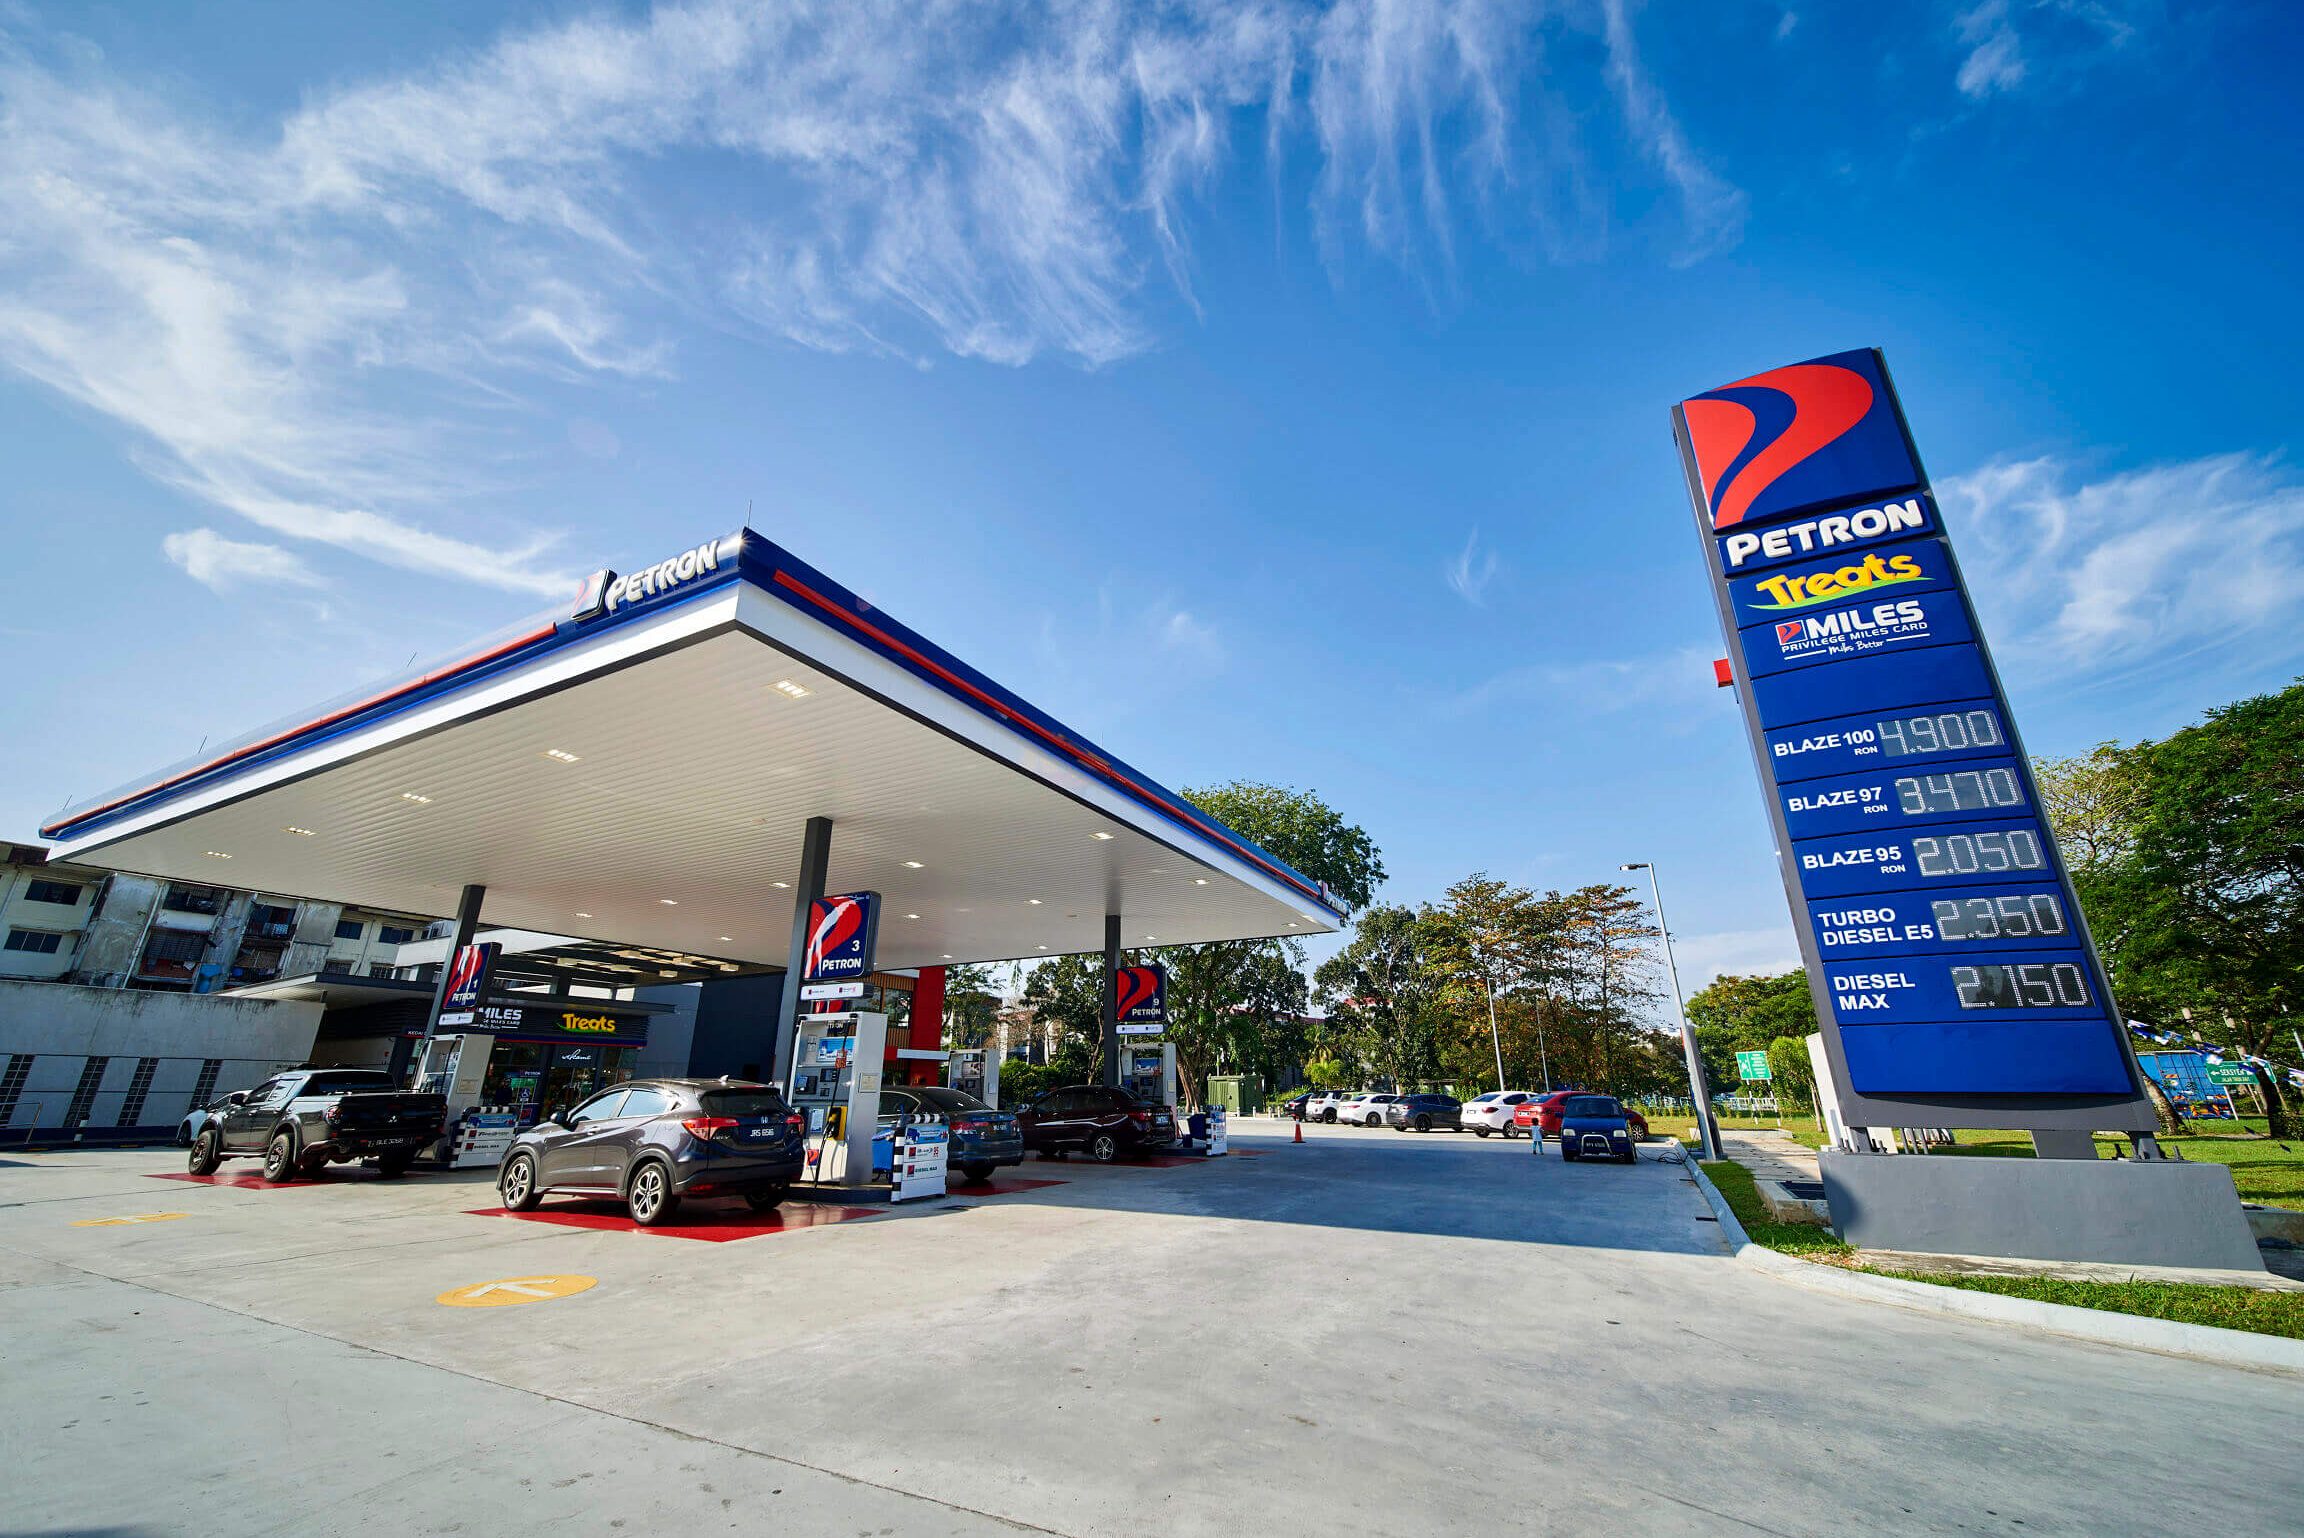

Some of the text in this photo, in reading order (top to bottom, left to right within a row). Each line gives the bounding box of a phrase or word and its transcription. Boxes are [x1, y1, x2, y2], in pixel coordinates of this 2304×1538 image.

[1725, 498, 1924, 567] PETRON
[605, 539, 720, 611] PETRON
[1756, 553, 1921, 606] Treats
[1805, 600, 1924, 639] MILES
[1781, 622, 1928, 653] PRIVILEGE MILES CARD
[1828, 640, 1884, 655] Miles Better
[1774, 710, 1999, 757] BLAZE 100 4.900
[1854, 745, 1878, 756] RON
[1788, 768, 2019, 815] BLAZE 97 3.470
[1863, 804, 1888, 814] RON
[1802, 830, 2041, 876] BLAZE 95 2.050
[1880, 864, 1906, 874] RON
[1818, 908, 1896, 927] TURBO
[1822, 894, 2065, 946] DIESEL E5 2.350
[852, 940, 860, 952] 3
[822, 957, 862, 971] PETRON
[473, 979, 479, 988] 1
[1833, 963, 2089, 1009] DIESEL 2.150
[451, 992, 477, 1002] PETRON
[1153, 998, 1160, 1006] 9
[1838, 993, 1890, 1011] MAX
[1132, 1008, 1161, 1017] PETRON
[562, 1013, 616, 1033] Treats
